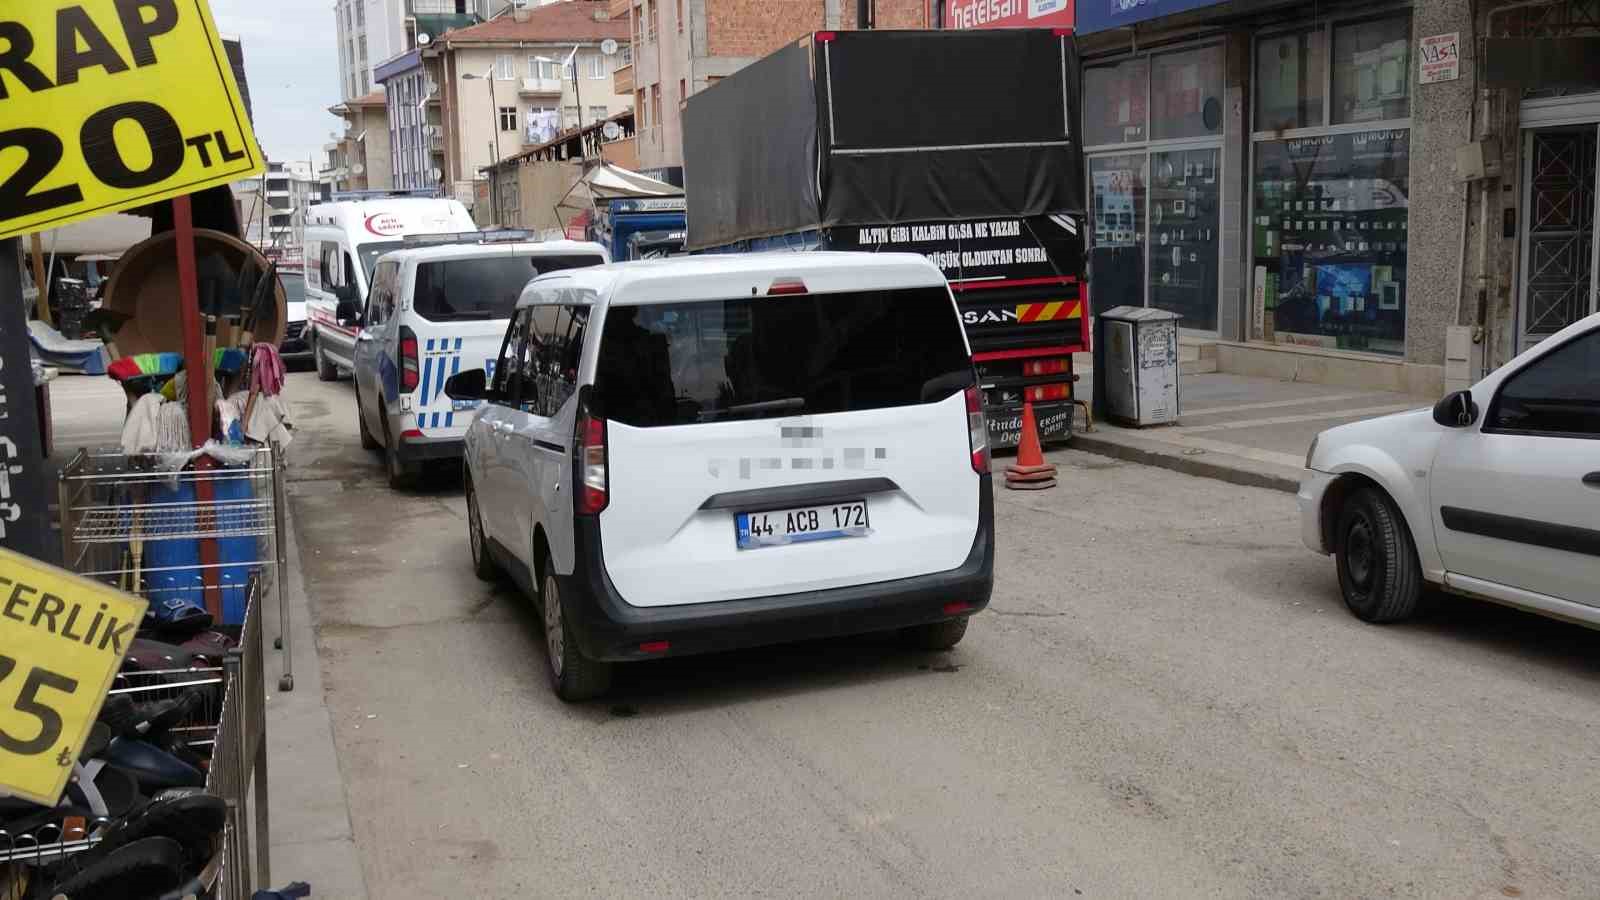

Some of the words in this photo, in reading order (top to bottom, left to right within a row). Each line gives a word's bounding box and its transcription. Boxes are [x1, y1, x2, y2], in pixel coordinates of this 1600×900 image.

[185, 130, 244, 168] TL
[859, 228, 889, 245] ALTIN
[911, 224, 946, 242] KALBİN
[948, 223, 973, 240] OLSA
[974, 222, 989, 239] NE
[989, 220, 1020, 237] YAZAR
[962, 248, 1013, 268] OLDUKTAN
[1015, 247, 1048, 264] SONRA
[960, 309, 1017, 325] SAN
[751, 514, 773, 537] 44
[786, 510, 819, 534] ACB
[832, 504, 865, 528] 172
